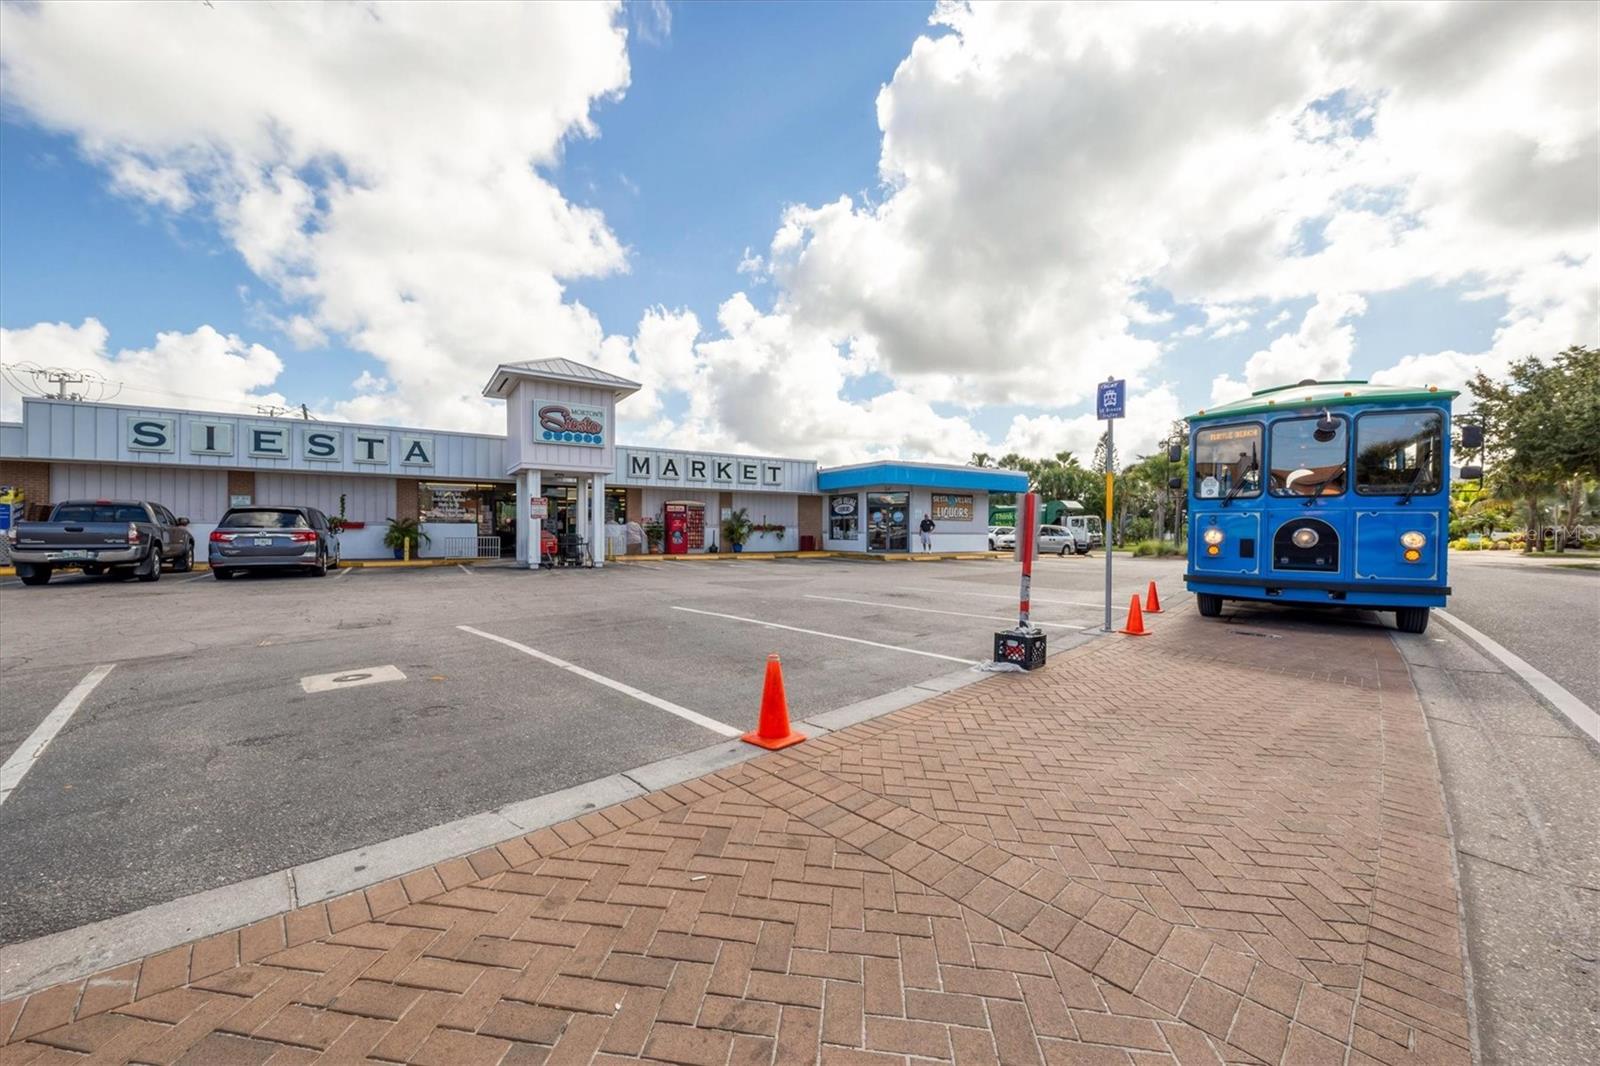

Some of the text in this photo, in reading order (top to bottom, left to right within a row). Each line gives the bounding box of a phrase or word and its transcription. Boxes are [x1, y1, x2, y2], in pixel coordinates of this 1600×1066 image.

[571, 409, 603, 417] MORTON'S
[538, 405, 603, 435] Siesta
[132, 421, 781, 482] SIESTA MARKET
[937, 507, 969, 518] LIQUORS
[1209, 515, 1217, 525] 3
